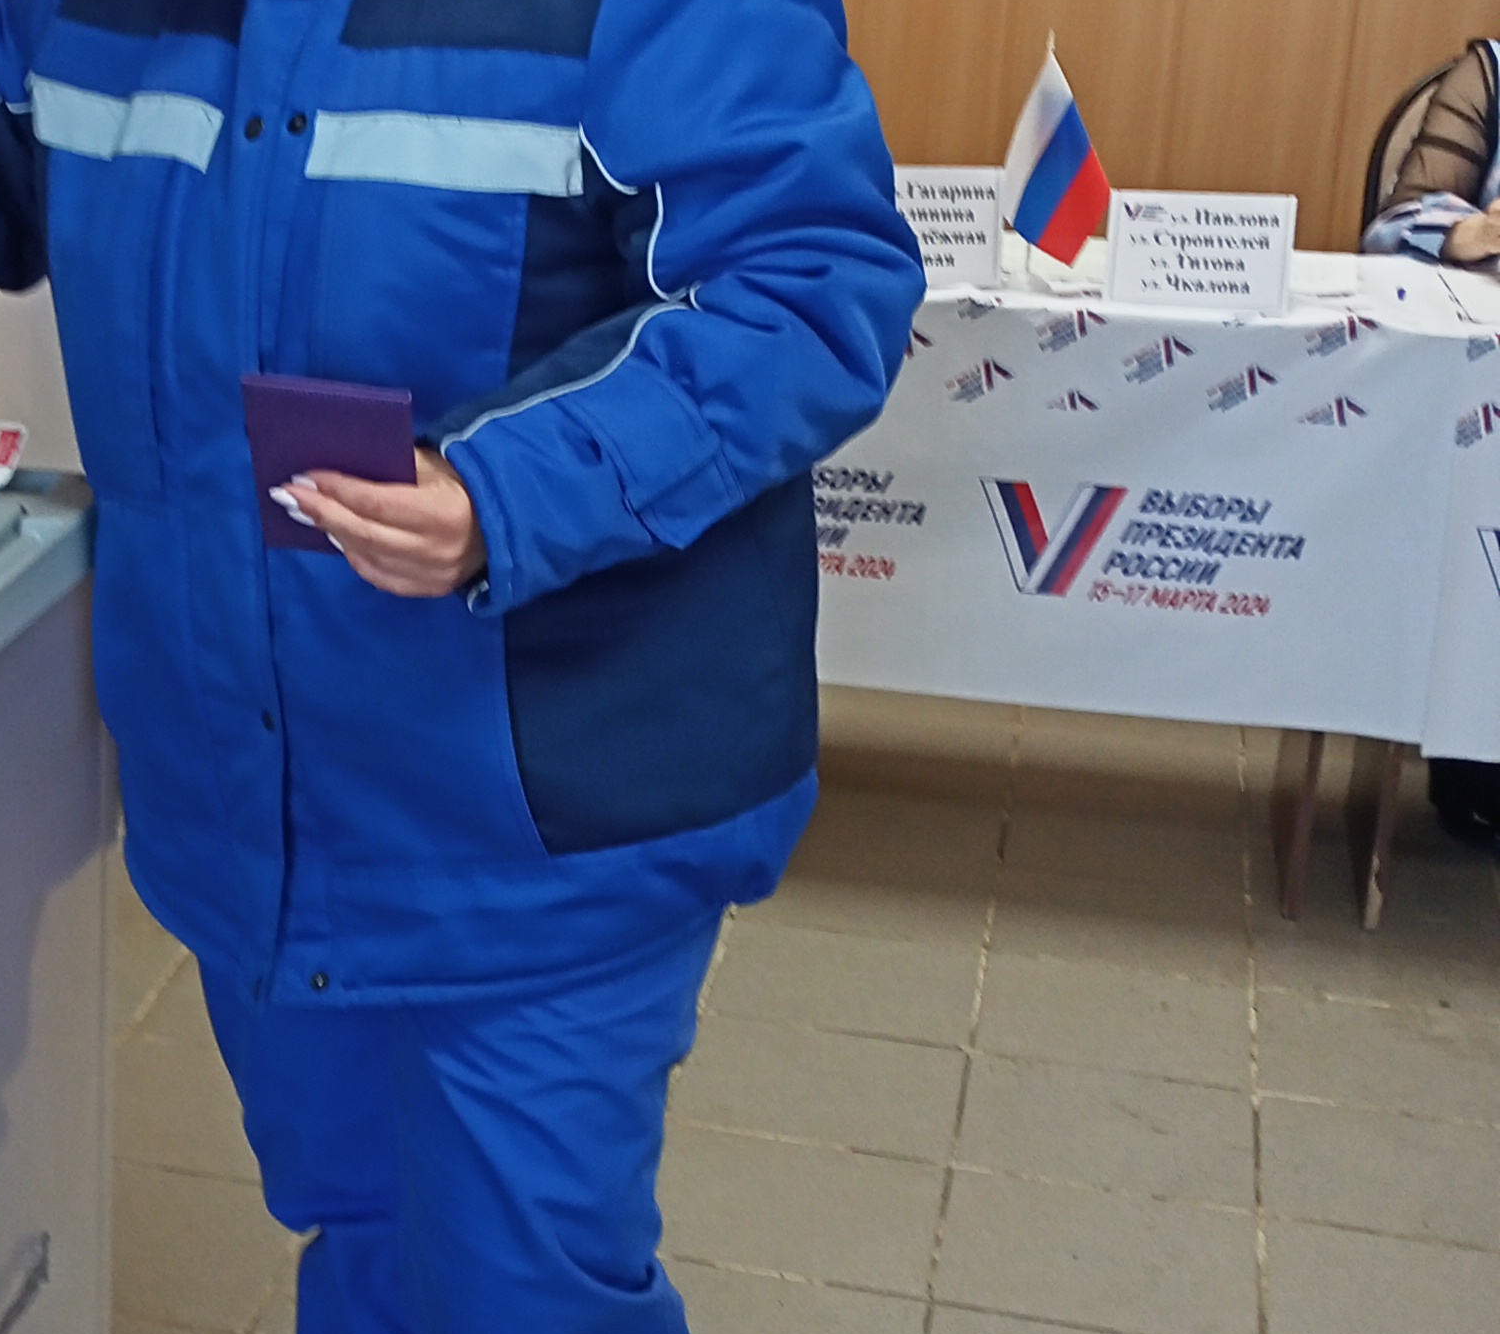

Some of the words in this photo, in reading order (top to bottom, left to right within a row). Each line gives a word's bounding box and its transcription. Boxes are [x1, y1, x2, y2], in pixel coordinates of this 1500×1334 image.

[906, 180, 996, 204] Гагарина
[1195, 207, 1281, 228] Павлова
[1154, 228, 1270, 251] Строителей
[1177, 252, 1247, 273] Титова
[1165, 273, 1251, 295] Чкалова
[1139, 487, 1273, 525] ВЫБОРЫ
[1120, 519, 1307, 561] ПРЕЗИДЕНТА
[849, 555, 896, 581] 2024
[1101, 549, 1223, 586] РОССИИ
[1145, 584, 1219, 613] МАРТА
[1219, 591, 1271, 618] 2024
